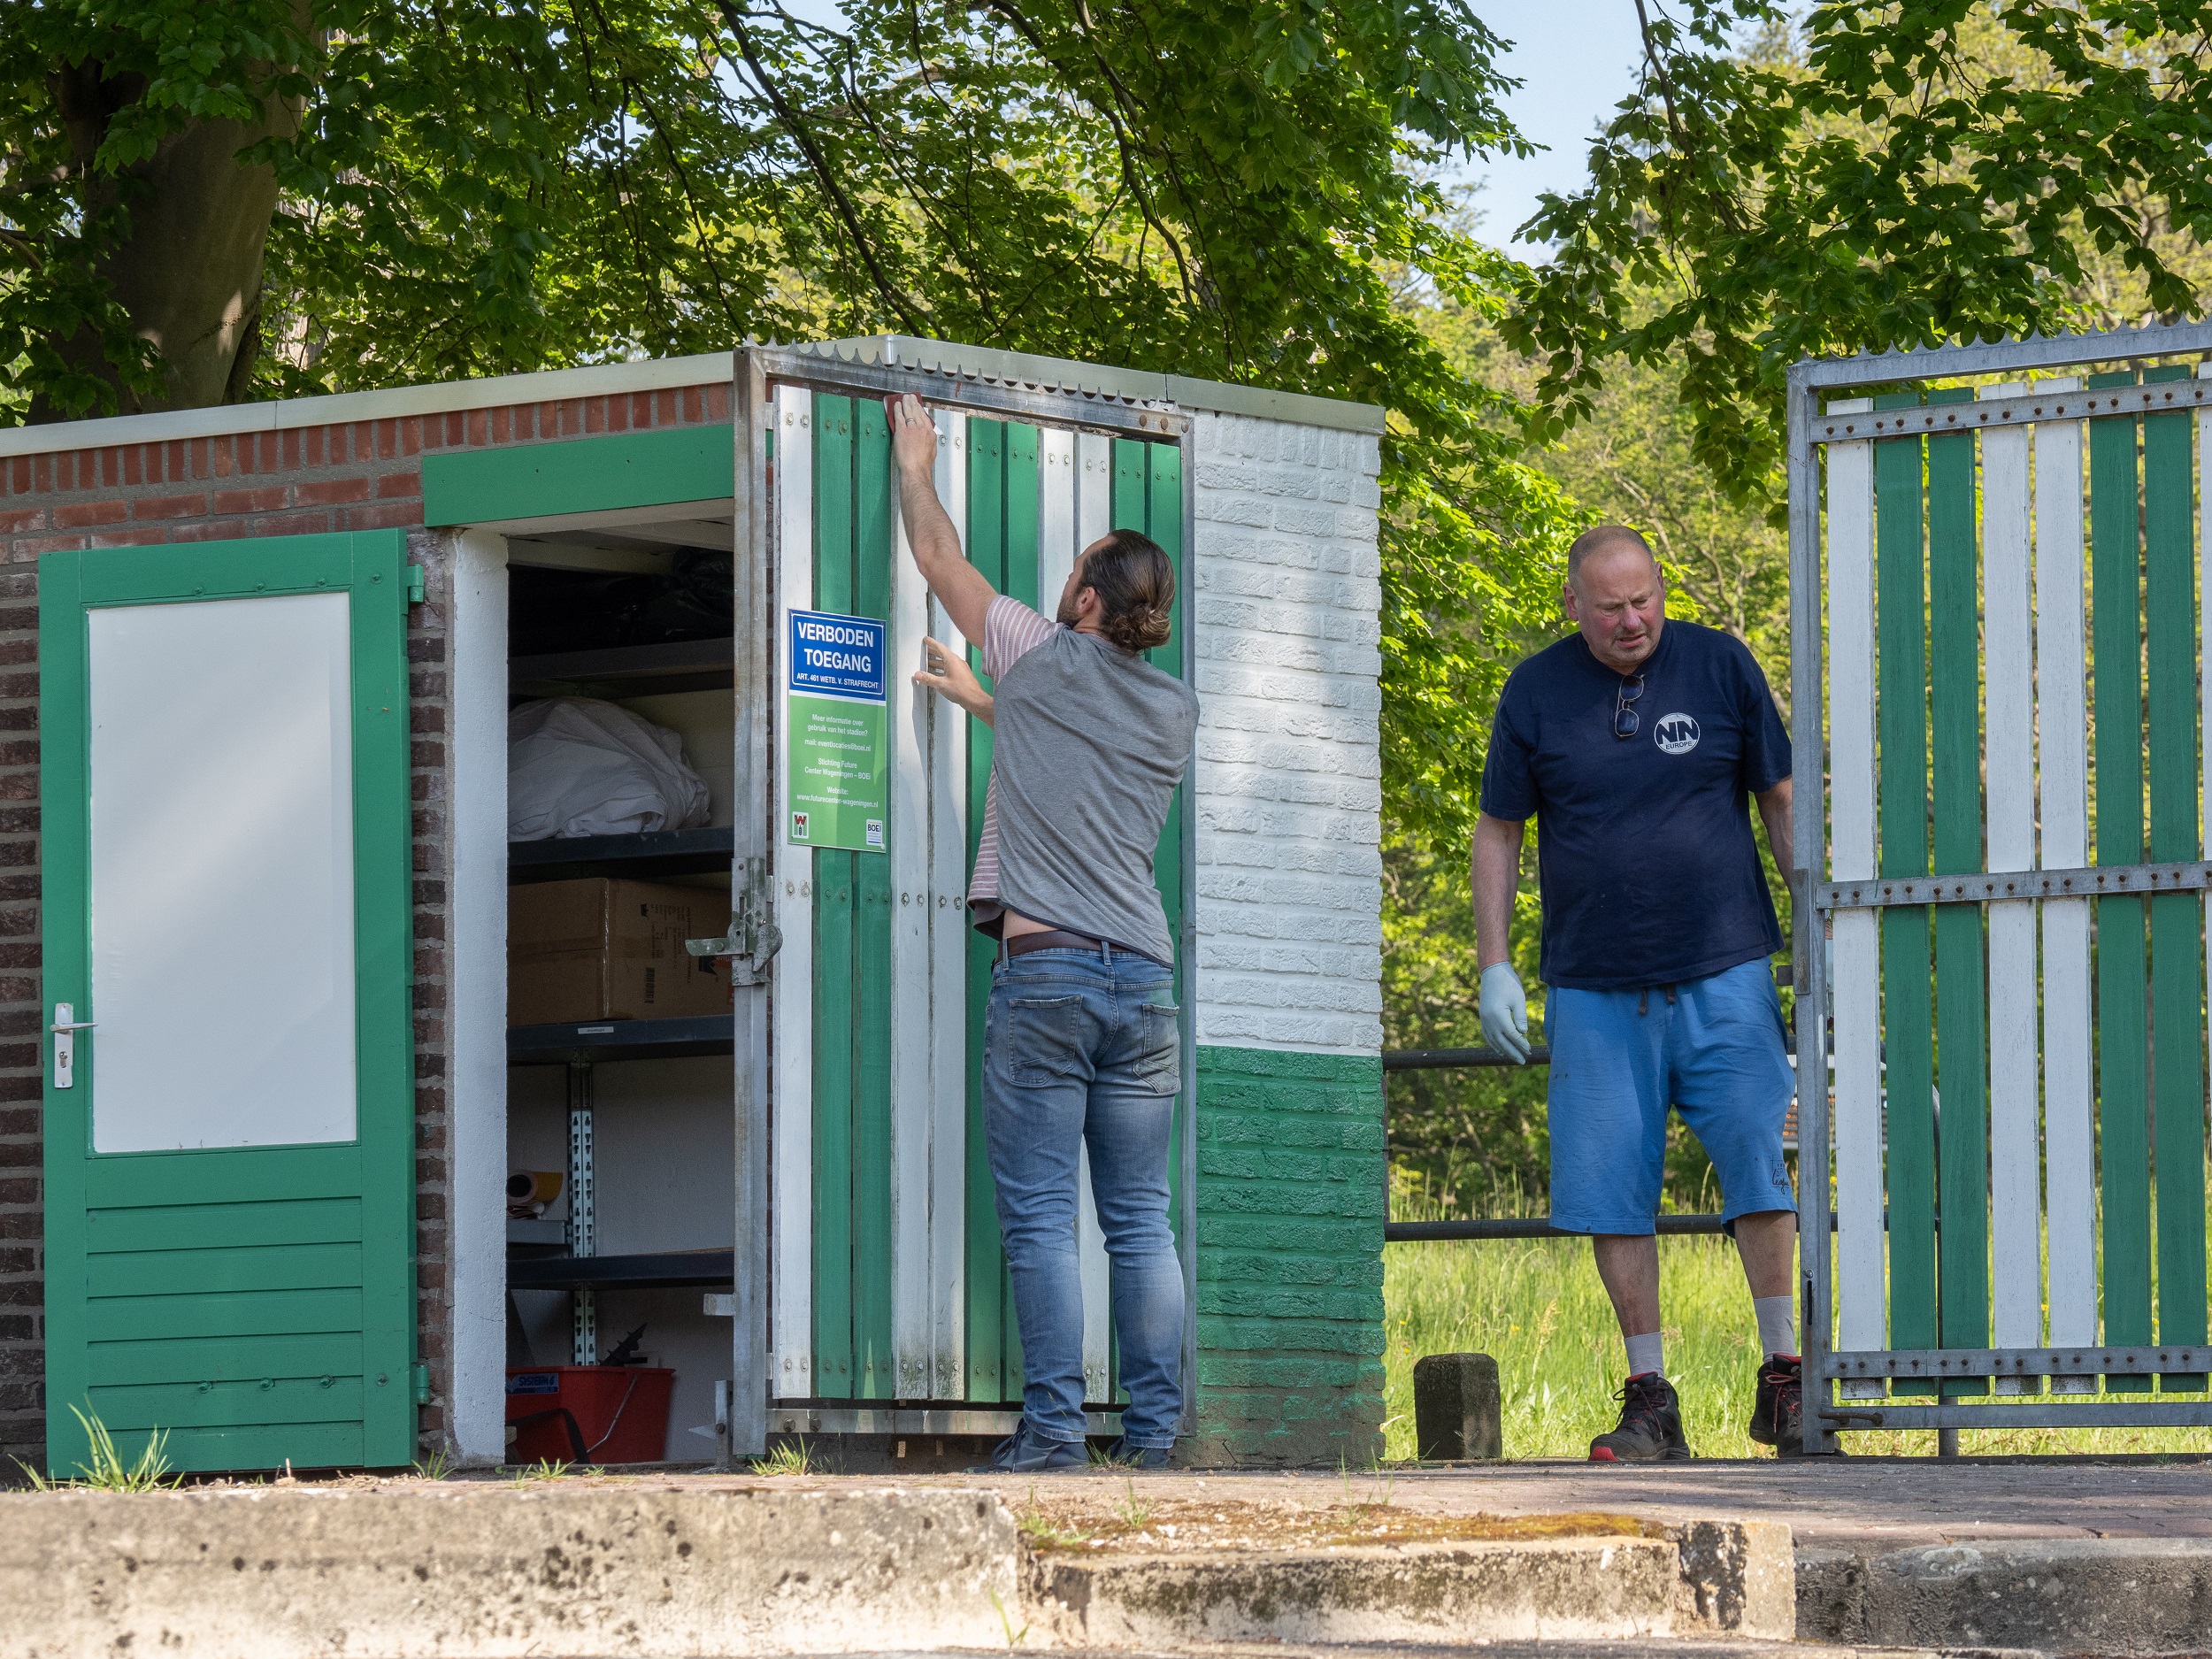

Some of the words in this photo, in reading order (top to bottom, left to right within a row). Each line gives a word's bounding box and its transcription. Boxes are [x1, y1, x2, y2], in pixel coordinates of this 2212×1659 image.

[798, 622, 873, 647] VERBODEN
[804, 649, 871, 672] TOEGANG
[844, 679, 879, 688] STRAFRECHT
[826, 716, 851, 726] informatie
[818, 741, 871, 751] eventlocaties@boei.nl
[818, 758, 840, 768] Stichting
[805, 766, 821, 775] Center
[823, 769, 853, 779] Wageningen
[827, 786, 849, 795] Website:
[797, 795, 878, 808] www.futurecenter-wageningen.nl
